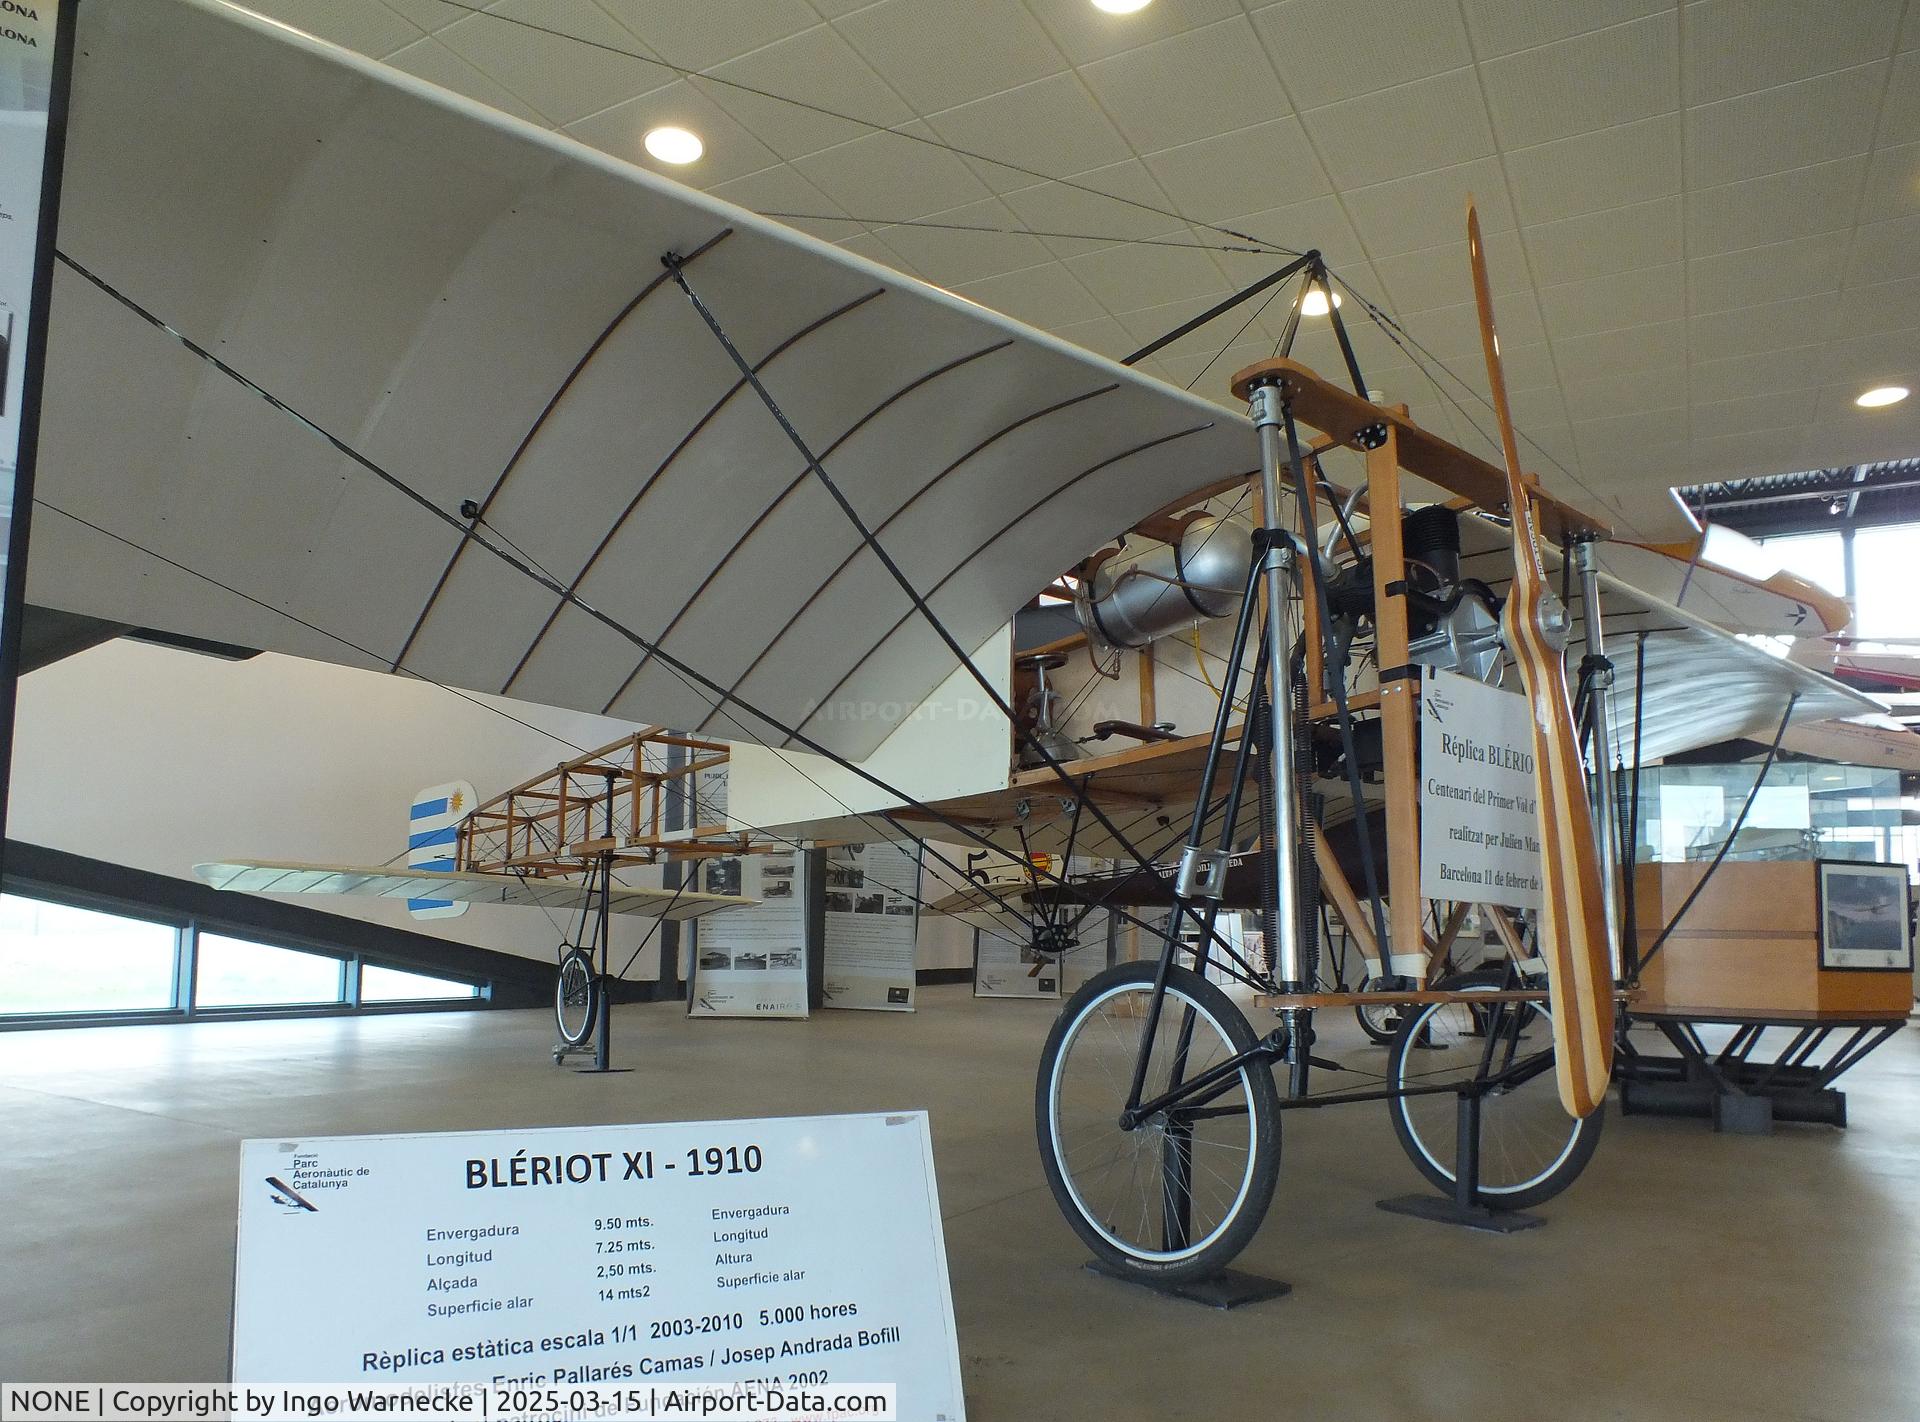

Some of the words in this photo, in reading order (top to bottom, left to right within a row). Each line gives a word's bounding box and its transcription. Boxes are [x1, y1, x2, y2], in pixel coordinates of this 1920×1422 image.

[1442, 733, 1485, 763] Réplica
[1428, 778, 1472, 802] Centenari
[1473, 787, 1485, 804] del
[1487, 790, 1514, 810] Primer
[1449, 825, 1484, 844] realitzat
[1485, 833, 1499, 850] per
[1500, 831, 1523, 850] Julien
[1440, 863, 1482, 883] Barcelona
[1494, 870, 1504, 886] de
[1505, 871, 1529, 889] febrer
[1529, 875, 1538, 890] de
[293, 1159, 318, 1169] Parc
[466, 1149, 612, 1189] BLÉRIOT
[623, 1151, 654, 1180] XI
[687, 1145, 763, 1177] 1910
[293, 1168, 354, 1179] Aeronàutic
[356, 1167, 370, 1176] de
[293, 1180, 348, 1190] Catalunya
[712, 1205, 790, 1221] Envergadura
[594, 1218, 622, 1231] 9.50
[626, 1216, 654, 1229] mts.
[427, 1225, 520, 1242] Envergadura
[713, 1228, 769, 1244] Longitud
[595, 1241, 623, 1254] 7.25
[627, 1240, 655, 1252] mts.
[427, 1250, 493, 1269] Longitud
[715, 1252, 753, 1266] Altura
[597, 1265, 625, 1280] 2,50
[628, 1263, 657, 1275] mts.
[717, 1274, 780, 1290] Superficie
[783, 1269, 806, 1281] alar
[427, 1276, 478, 1293] Alçada
[598, 1290, 614, 1301] 14
[617, 1286, 651, 1300] mts2
[427, 1299, 503, 1319] Superficie
[506, 1296, 534, 1309] alar
[362, 1348, 445, 1372] Rèplica
[451, 1339, 534, 1362] estàtica
[540, 1328, 605, 1350] escala
[611, 1325, 638, 1344] 1/1
[650, 1313, 744, 1340] 2003-2010
[759, 1306, 805, 1326] 5.000
[810, 1302, 858, 1319] hores
[553, 1362, 633, 1384] Pallarés
[639, 1355, 705, 1376] Camas
[720, 1347, 775, 1370] Josep
[780, 1335, 853, 1357] Andrada
[858, 1326, 901, 1346] Bofill
[788, 1369, 829, 1390] 2002
